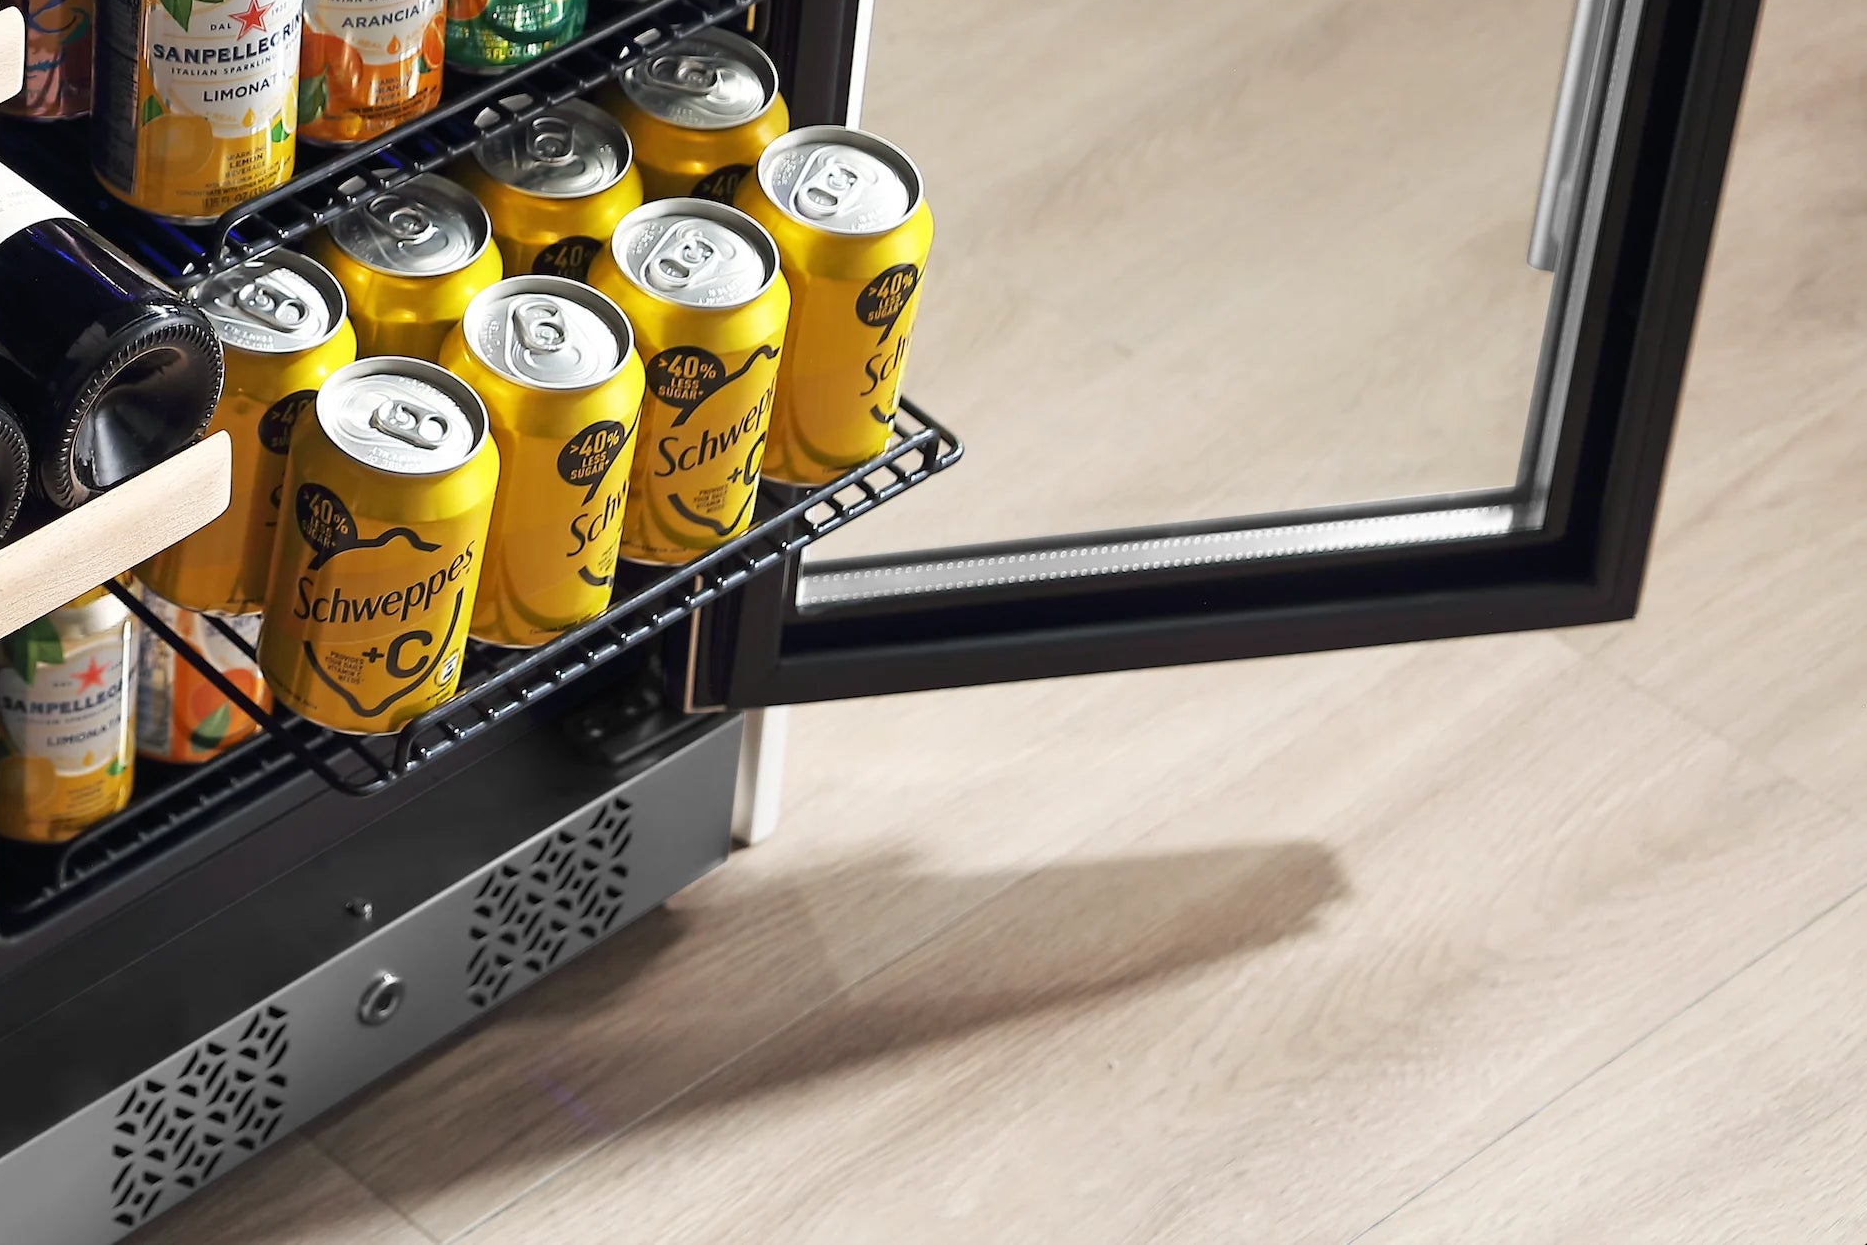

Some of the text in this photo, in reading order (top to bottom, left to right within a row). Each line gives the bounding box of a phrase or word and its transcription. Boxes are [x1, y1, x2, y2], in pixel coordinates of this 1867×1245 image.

[210, 23, 232, 32] DAL
[171, 67, 218, 77] ITALIAN
[229, 153, 264, 169] LEMON
[657, 354, 717, 380] >40%
[670, 375, 700, 391] LESS
[570, 429, 621, 458] >40%
[581, 452, 608, 471] LESS
[294, 539, 476, 623] Schweppes
[362, 629, 434, 679] +C
